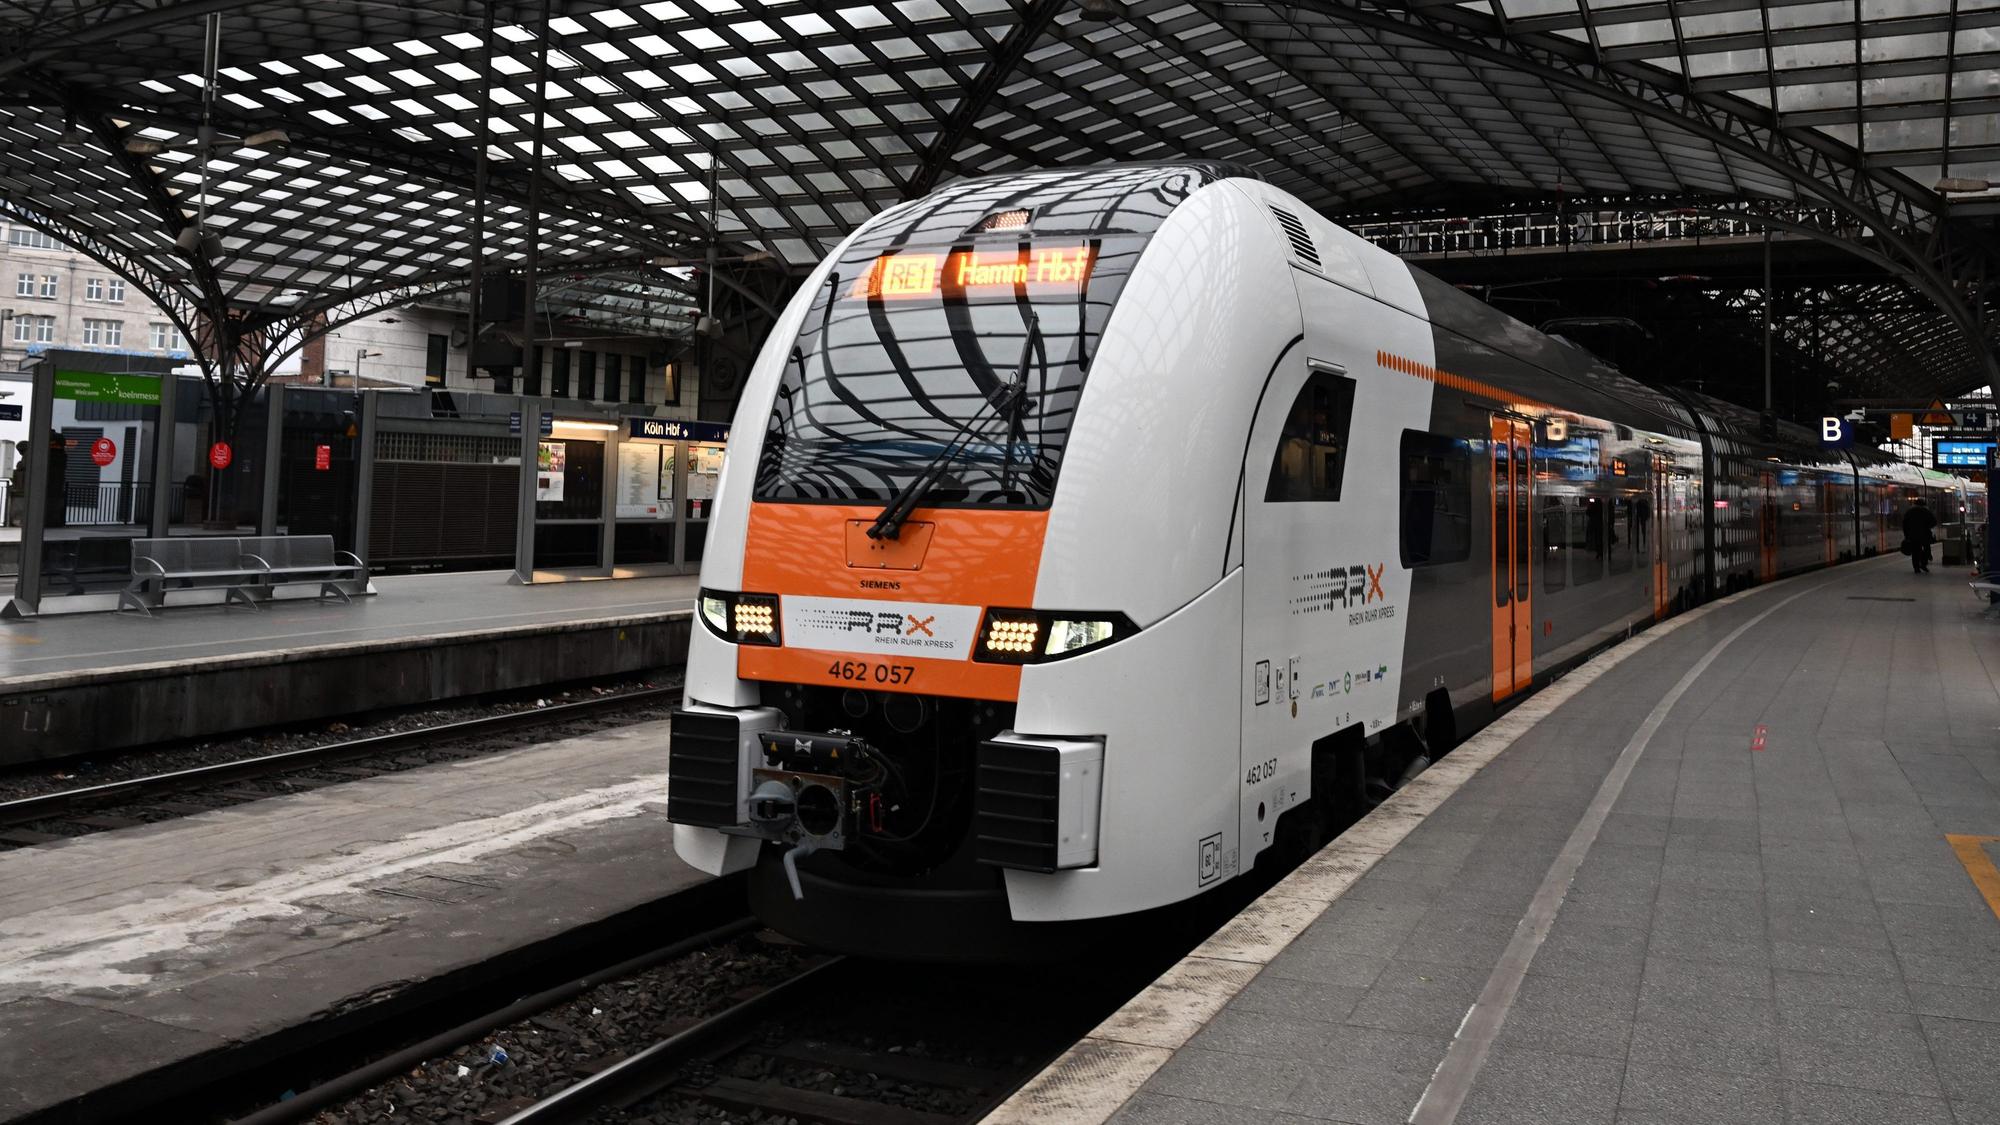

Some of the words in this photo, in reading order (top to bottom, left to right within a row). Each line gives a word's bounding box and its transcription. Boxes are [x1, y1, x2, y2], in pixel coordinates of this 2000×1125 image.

[889, 261, 928, 290] RE1
[957, 255, 1027, 286] Hamm
[1036, 250, 1087, 282] Hbf
[118, 390, 160, 401] koelnmesse
[644, 421, 664, 436] Köln
[665, 422, 681, 437] Hbf
[1821, 416, 1843, 442] B
[859, 579, 901, 590] SIEMENS
[1349, 611, 1364, 625] RHEIN
[1365, 608, 1378, 622] RUHR
[1378, 605, 1395, 619] XPRESS
[874, 636, 899, 645] RHEIN
[900, 637, 922, 647] RUHR
[924, 638, 955, 649] XPRESS
[828, 660, 868, 682] 462
[874, 665, 916, 685] 057
[1246, 765, 1261, 786] 462
[1263, 758, 1278, 779] 057
